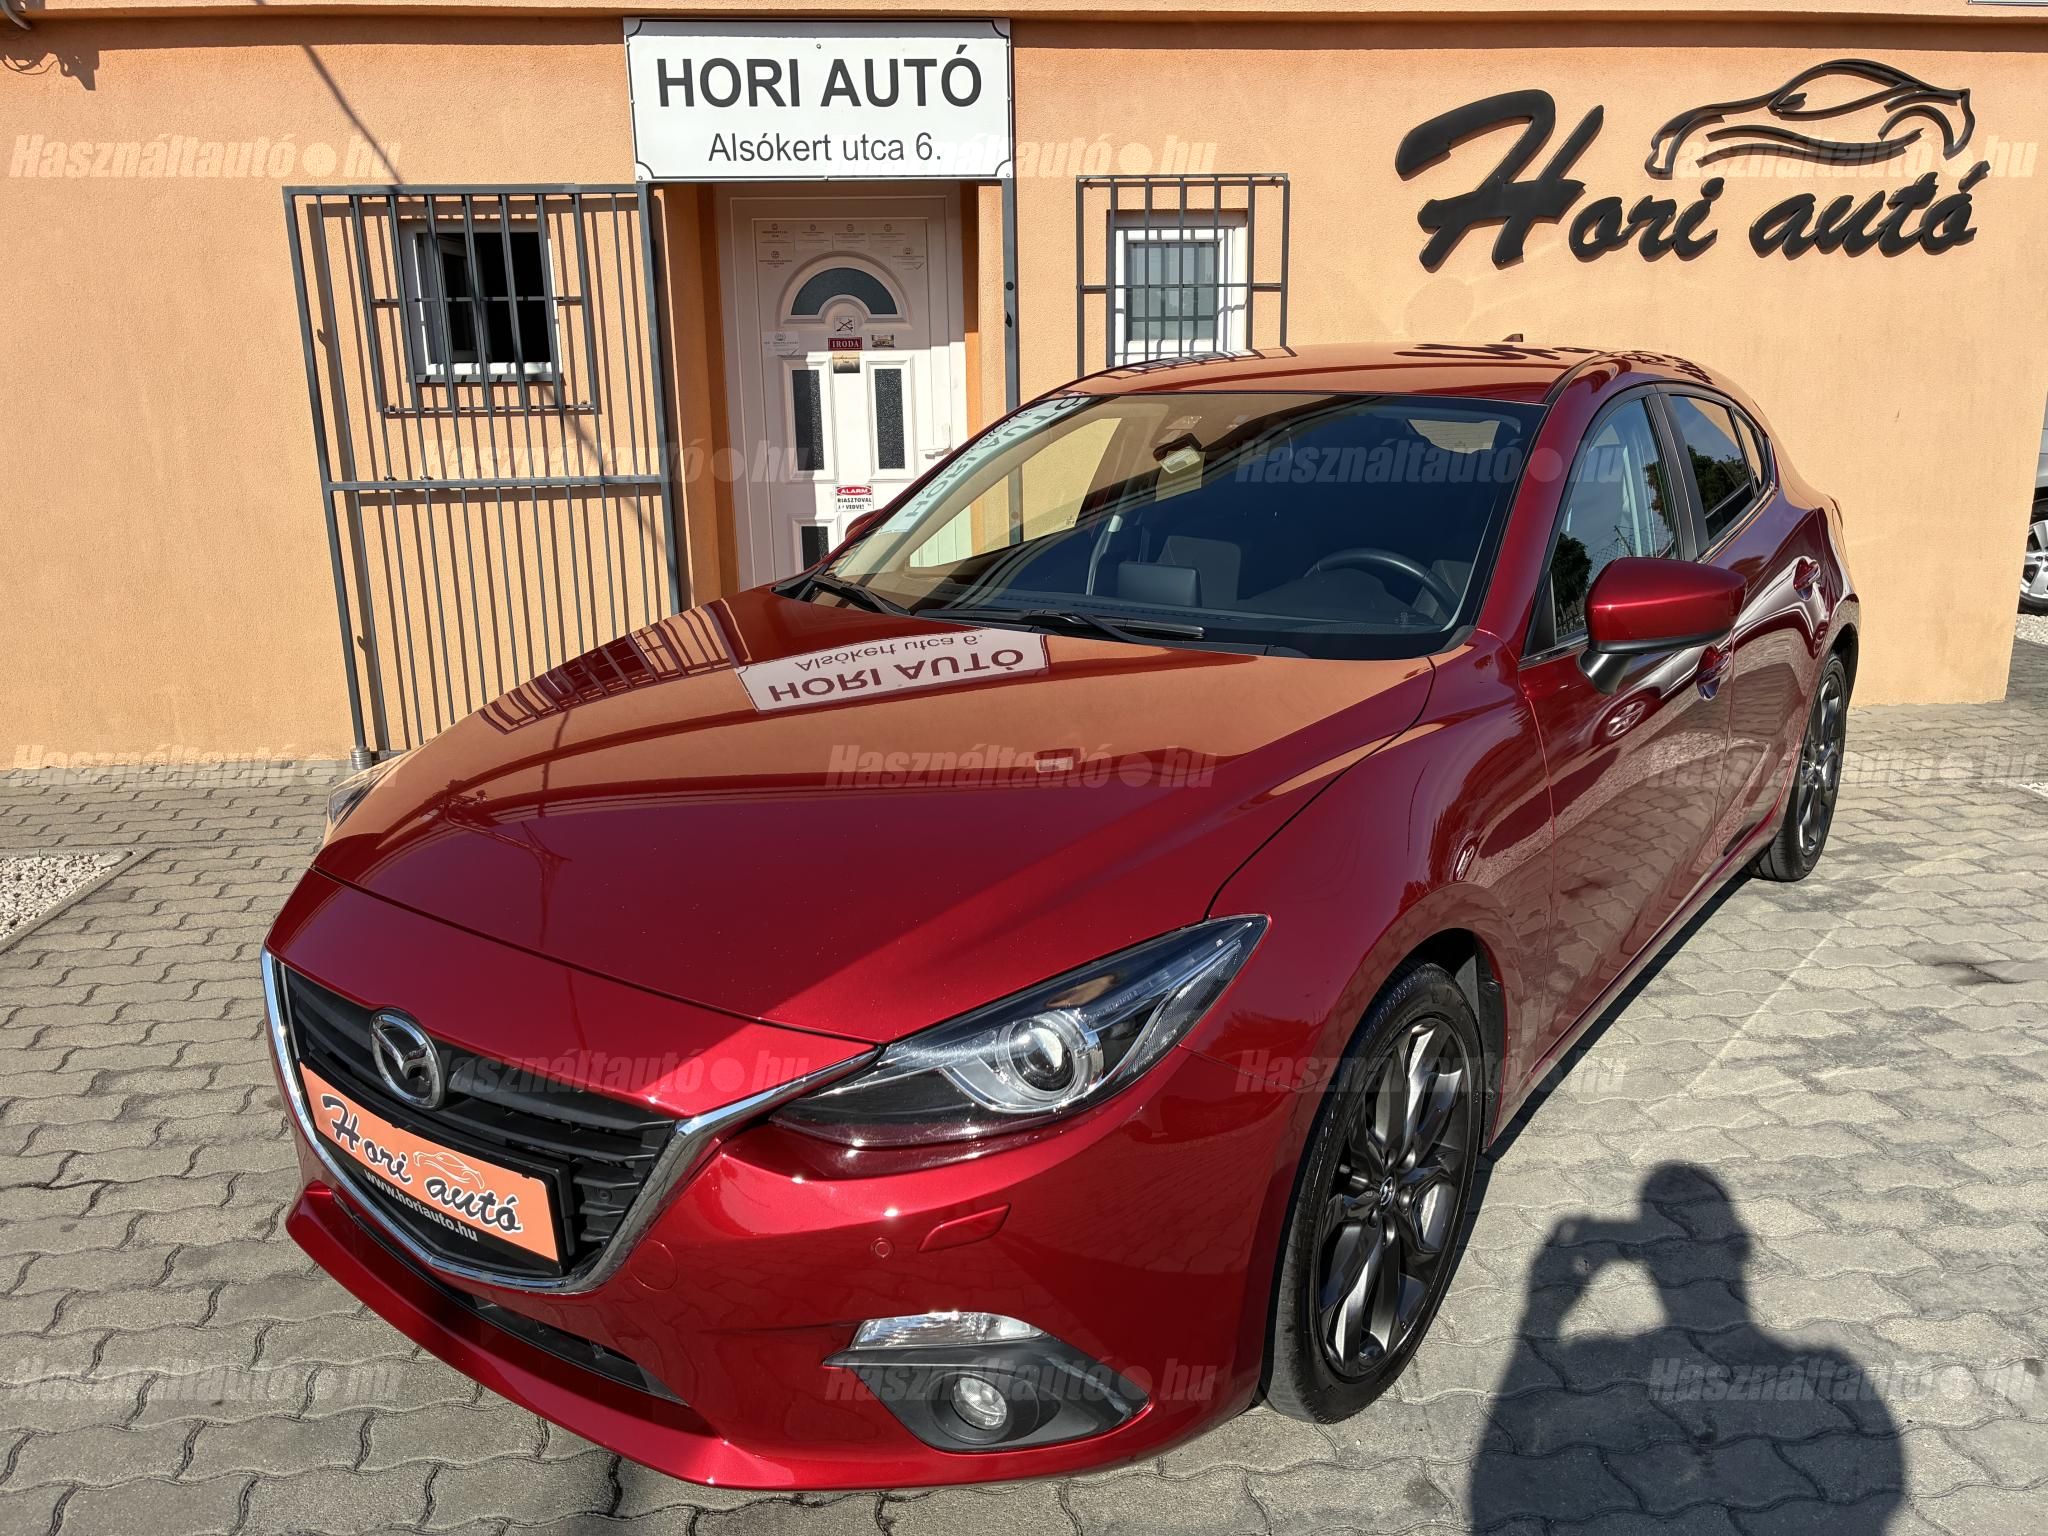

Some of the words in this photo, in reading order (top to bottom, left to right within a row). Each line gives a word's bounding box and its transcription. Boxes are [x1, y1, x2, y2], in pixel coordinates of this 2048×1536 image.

[656, 58, 800, 108] HORI
[820, 44, 982, 108] AUTÓ
[708, 132, 832, 162] Alsókert
[842, 133, 905, 162] utca
[915, 132, 942, 162] 6.
[1395, 88, 1725, 273] Hori
[1748, 159, 1990, 261] autó
[832, 340, 860, 348] IRODA
[321, 1093, 412, 1184] Hori
[424, 1176, 523, 1234] autó
[363, 1169, 478, 1242] www.horiauto.hu
